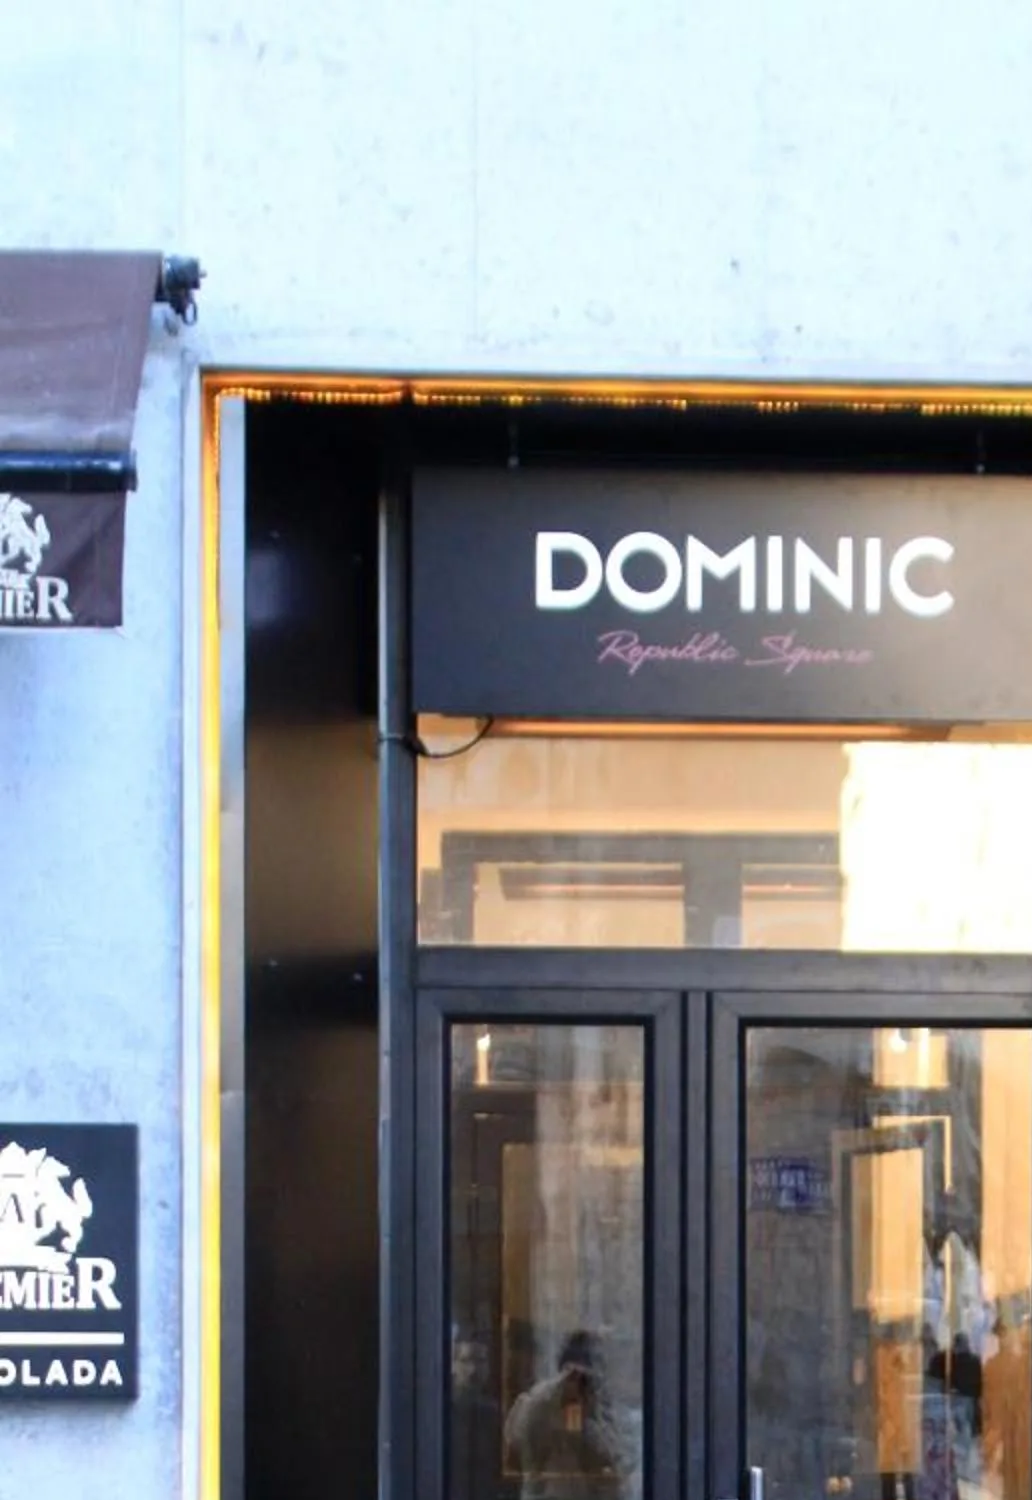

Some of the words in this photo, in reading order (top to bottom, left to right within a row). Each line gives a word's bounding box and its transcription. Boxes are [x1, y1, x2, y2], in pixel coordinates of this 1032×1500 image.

[535, 531, 955, 617] DOMINIC
[597, 630, 739, 676] Republic
[744, 631, 876, 675] Square
[0, 1257, 122, 1310] MIER
